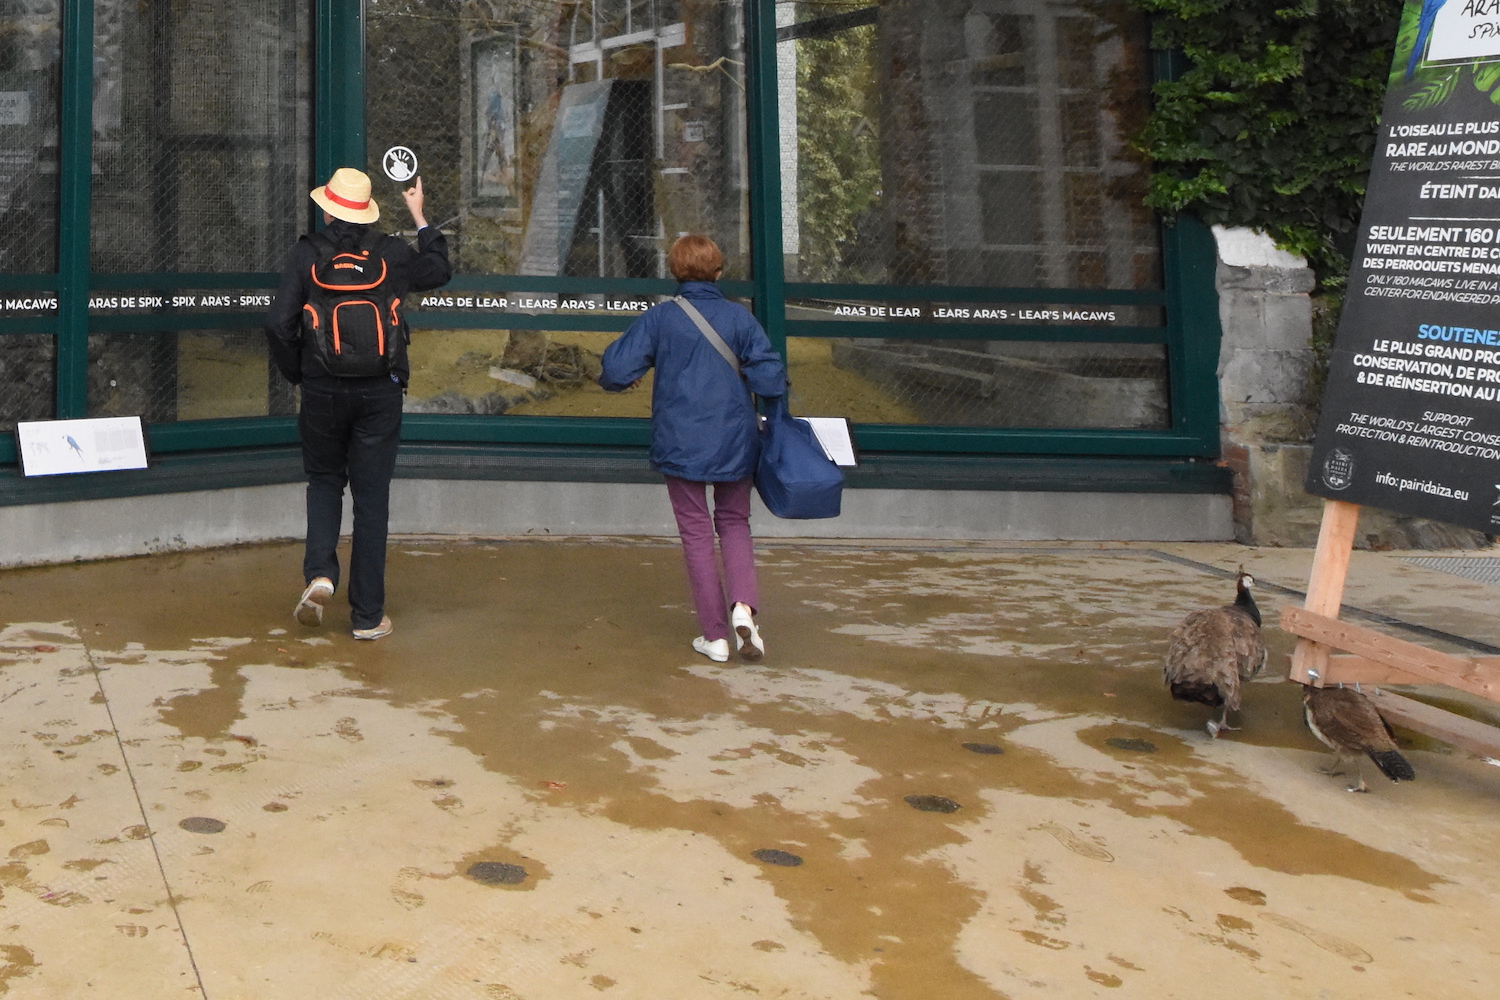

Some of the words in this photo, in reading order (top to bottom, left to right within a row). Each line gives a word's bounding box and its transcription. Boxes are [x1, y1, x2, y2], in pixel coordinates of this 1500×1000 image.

[1389, 124, 1446, 137] L'OISEAU
[1447, 123, 1464, 135] LE
[1465, 121, 1499, 134] PLUS
[1386, 142, 1428, 157] RARE
[1428, 144, 1447, 156] AU
[1449, 140, 1500, 155] MOND
[1389, 162, 1409, 171] THE
[1408, 161, 1451, 171] WORLD'S
[1450, 160, 1491, 170] RAREST
[1420, 181, 1478, 198] ÉTEINT
[1368, 226, 1463, 242] SEULEMENT
[1464, 228, 1494, 243] 160
[1366, 244, 1406, 255] VIVENT
[1406, 245, 1423, 256] EN
[1424, 246, 1470, 258] CENTRE
[1471, 247, 1489, 258] DE
[1362, 258, 1385, 269] DES
[1385, 259, 1461, 273] PERROQUETS
[1366, 274, 1393, 285] ONLY
[1392, 276, 1409, 286] 160
[1408, 276, 1454, 288] MACAWS
[1454, 279, 1479, 290] LIVE
[1477, 281, 1491, 291] IN
[1489, 281, 1498, 291] A
[88, 298, 118, 309] ARAS
[121, 298, 136, 308] DE
[138, 297, 162, 307] SPIX
[172, 296, 196, 307] SPIX
[201, 296, 230, 306] ARA'S
[240, 296, 271, 306] SPIX'S
[1363, 286, 1402, 298] CENTER
[1400, 288, 1422, 300] FOR
[1421, 290, 1491, 304] ENDANGERED
[6, 298, 58, 310] MACAWS
[421, 297, 454, 308] ARAS
[457, 298, 473, 308] DE
[476, 298, 508, 308] LEAR
[519, 298, 558, 309] LEARS
[560, 299, 595, 310] ARA'S
[607, 300, 649, 311] LEAR'S
[834, 306, 867, 316] ARAS
[869, 307, 886, 317] DE
[889, 307, 920, 317] LEAR
[933, 308, 970, 319] LEARS
[973, 309, 1008, 319] ARA'S
[1019, 309, 1060, 320] LEAR'S
[1062, 310, 1115, 321] MACAWS
[1373, 339, 1390, 352] LE
[1390, 341, 1424, 356] PLUS
[1424, 344, 1473, 361] GRAND
[1353, 353, 1454, 379] CONSERVATION,
[1455, 366, 1476, 380] DE
[1356, 371, 1366, 384] &
[1366, 372, 1385, 386] DE
[1385, 373, 1474, 398] RÉINSERTION
[1474, 386, 1495, 401] AU
[1349, 412, 1369, 425] THE
[1369, 415, 1415, 432] WORLD'S
[1413, 423, 1464, 439] LARGEST
[1421, 410, 1474, 427] SUPPORT
[1335, 423, 1399, 443] PROTECTION
[1398, 434, 1406, 444] &
[1375, 471, 1399, 487] info:
[1399, 478, 1469, 501] pairidaiza.eu
